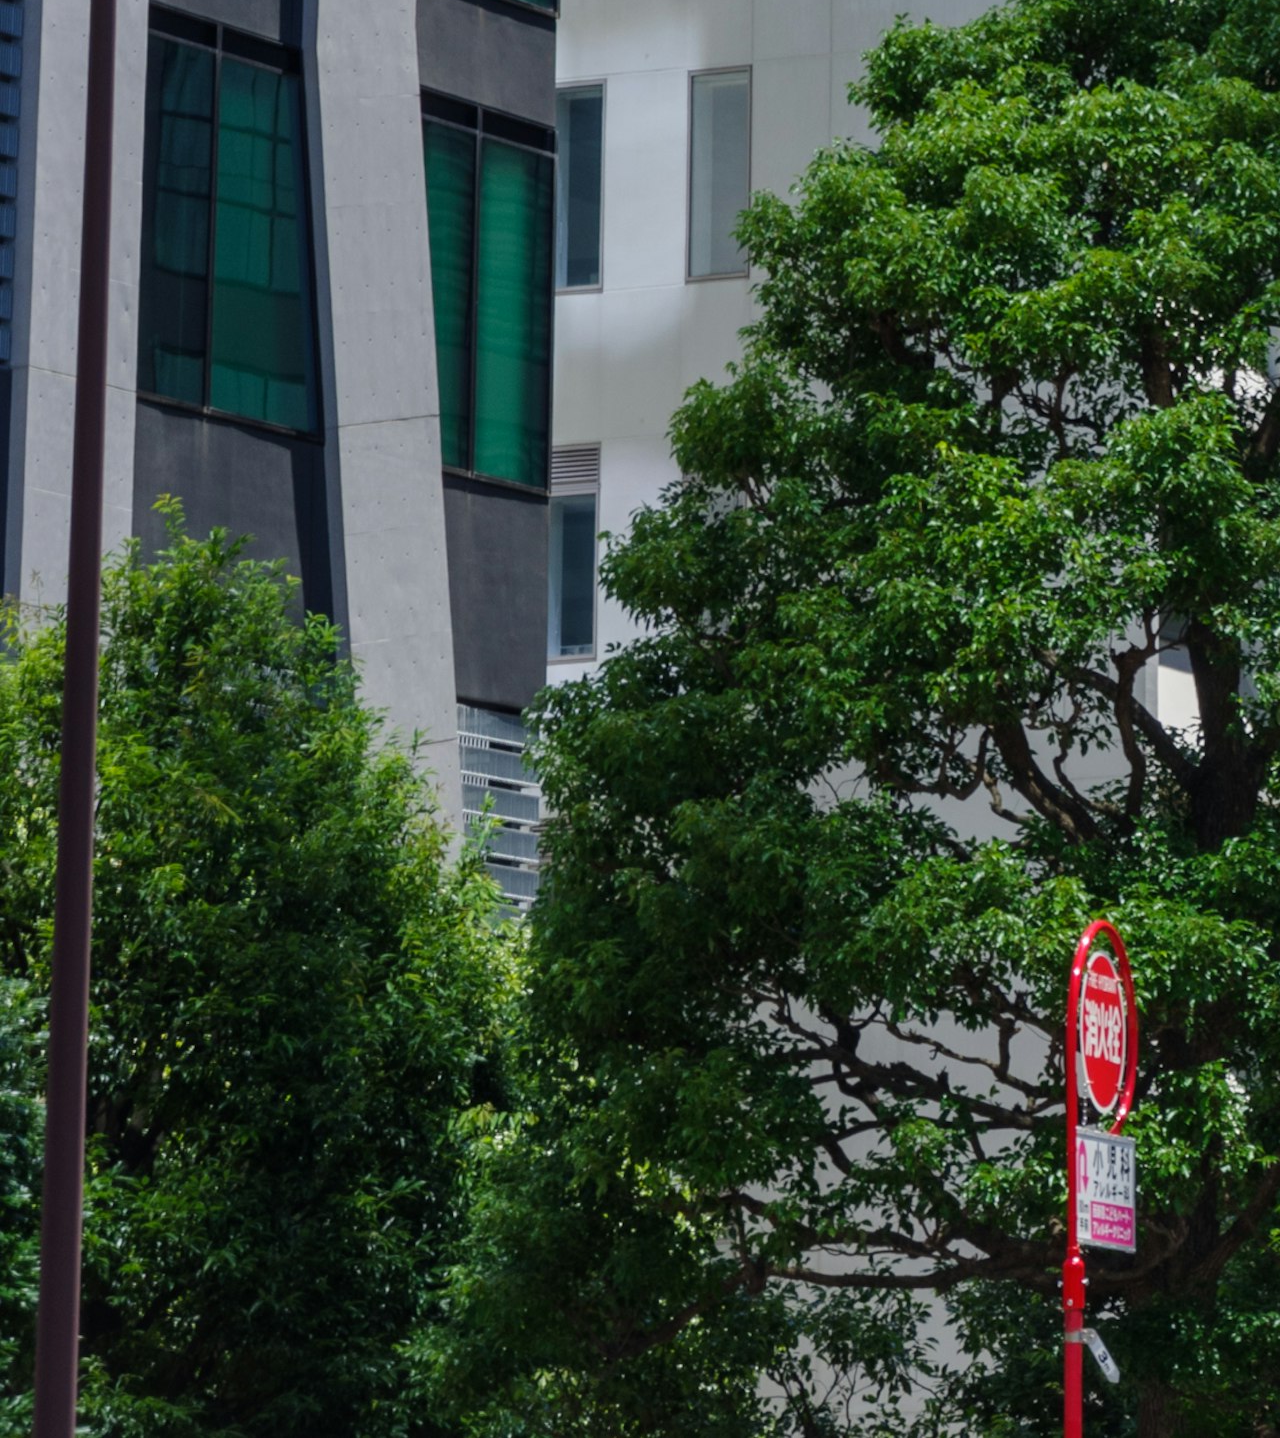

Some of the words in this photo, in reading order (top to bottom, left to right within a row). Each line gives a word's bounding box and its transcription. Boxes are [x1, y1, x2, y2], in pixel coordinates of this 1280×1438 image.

[1084, 998, 1122, 1065] 消火栓
[1092, 1141, 1131, 1182] 小児科
